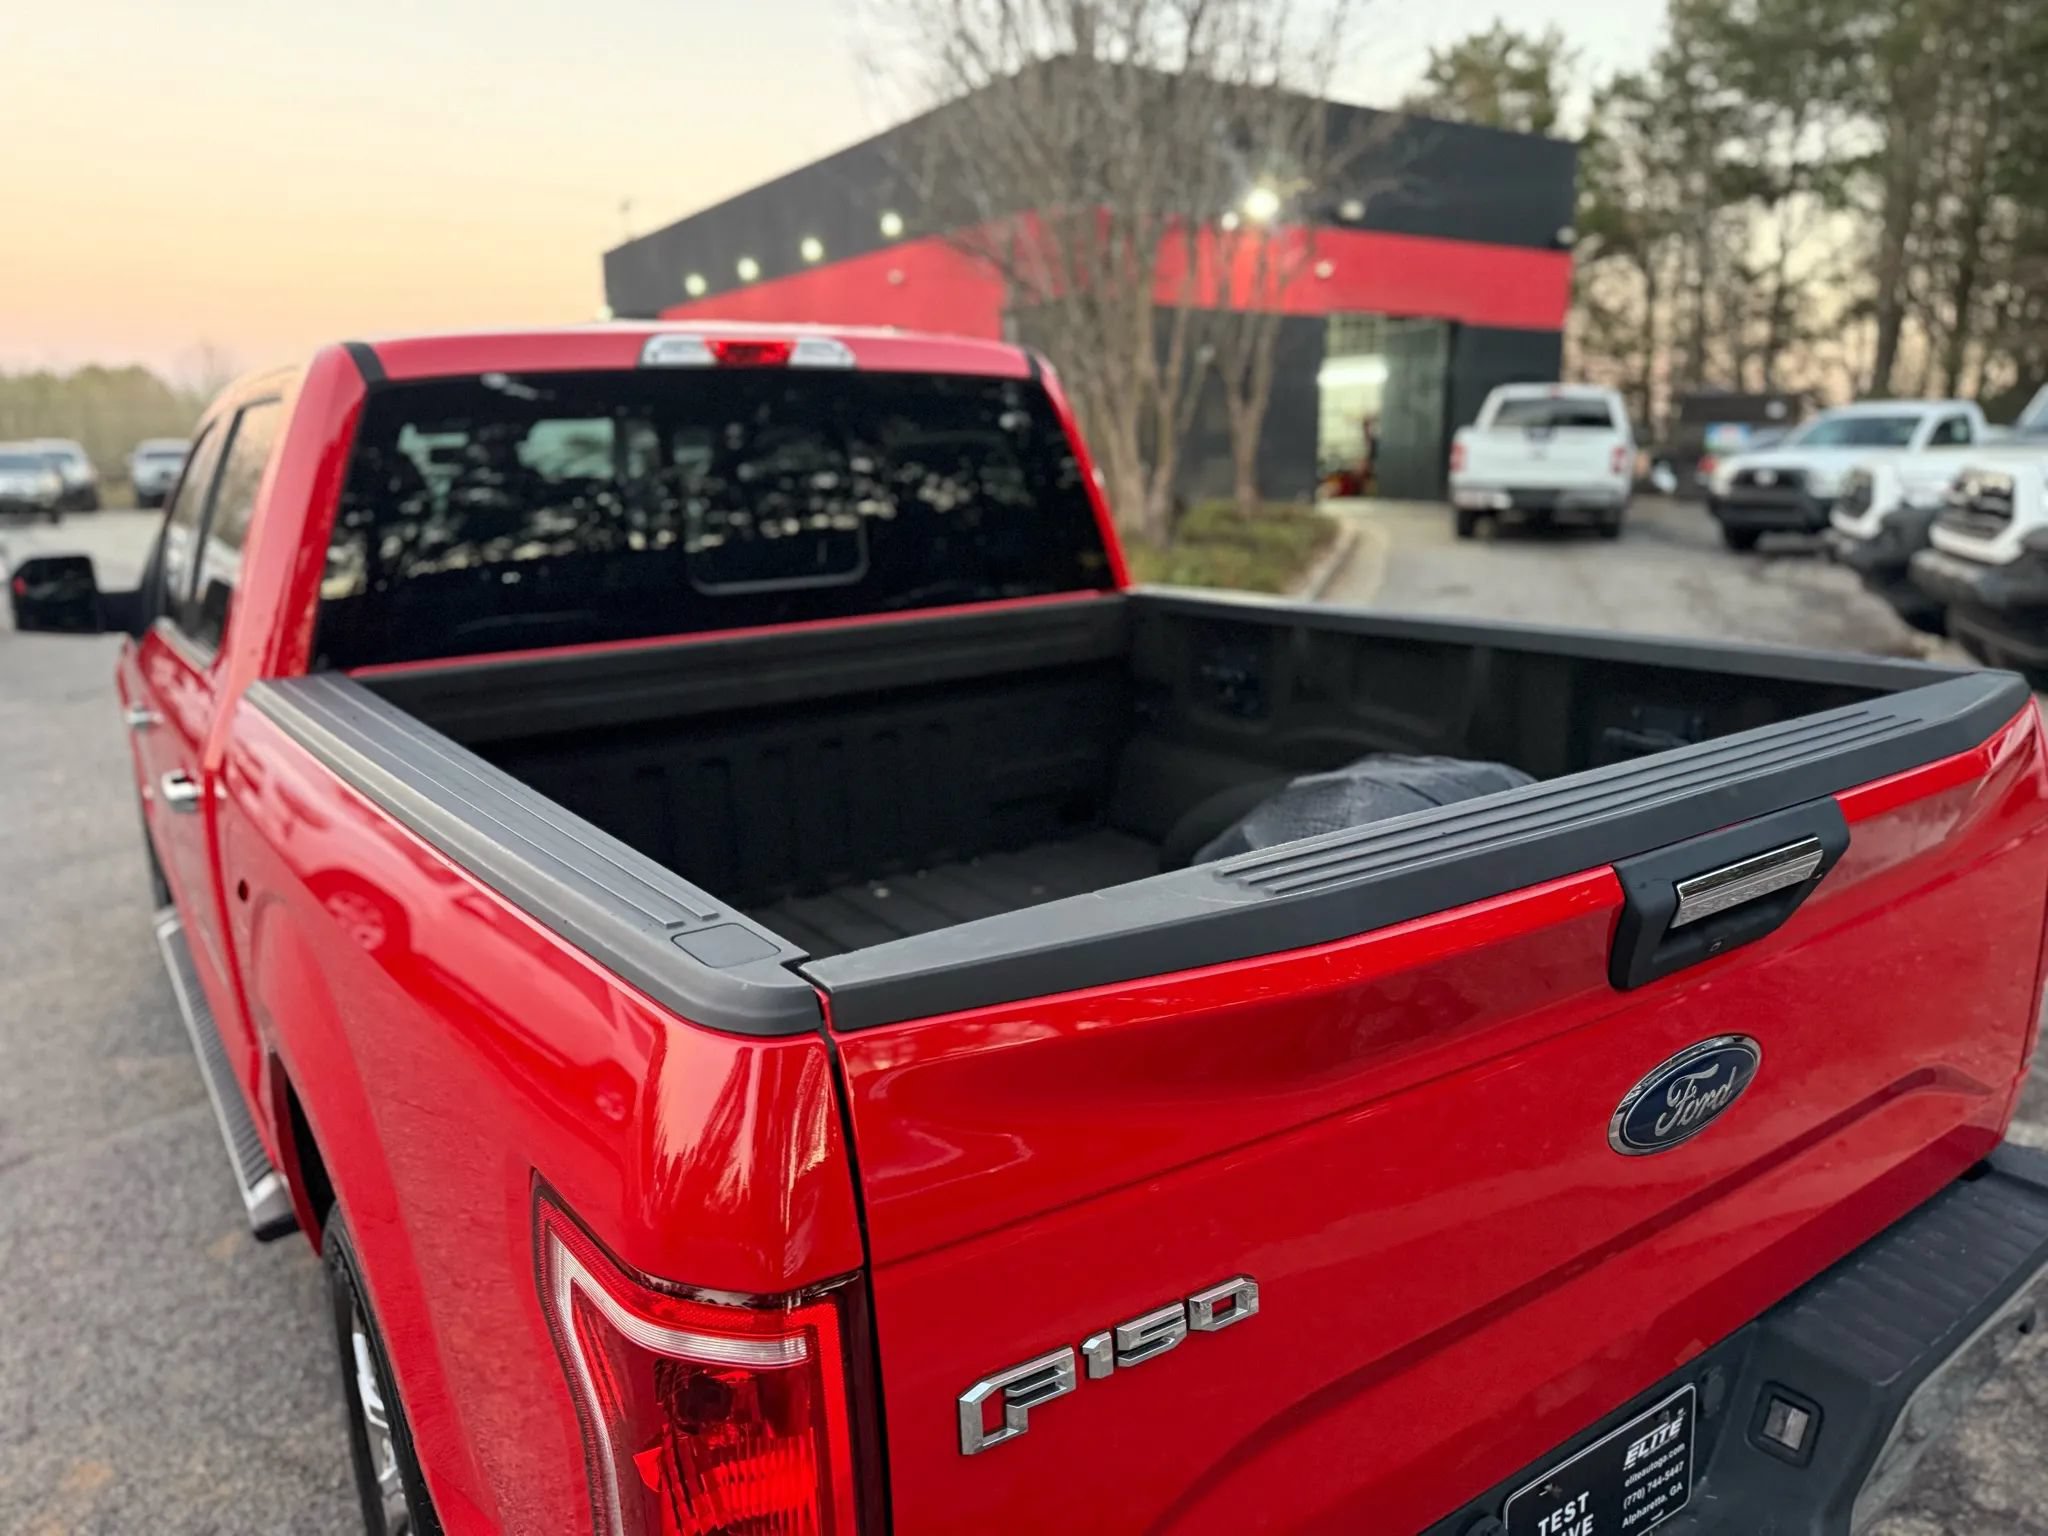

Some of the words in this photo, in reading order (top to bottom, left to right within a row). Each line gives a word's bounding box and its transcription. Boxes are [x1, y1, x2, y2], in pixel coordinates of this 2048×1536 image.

[1655, 1063, 1737, 1137] Ford
[1623, 1416, 1684, 1468] ELITE
[1624, 1442, 1686, 1488] eliteautoga.com
[1623, 1486, 1646, 1510] (770)
[1647, 1460, 1685, 1493] 744-5447
[1669, 1481, 1684, 1497] GA
[1537, 1490, 1590, 1536] TEST
